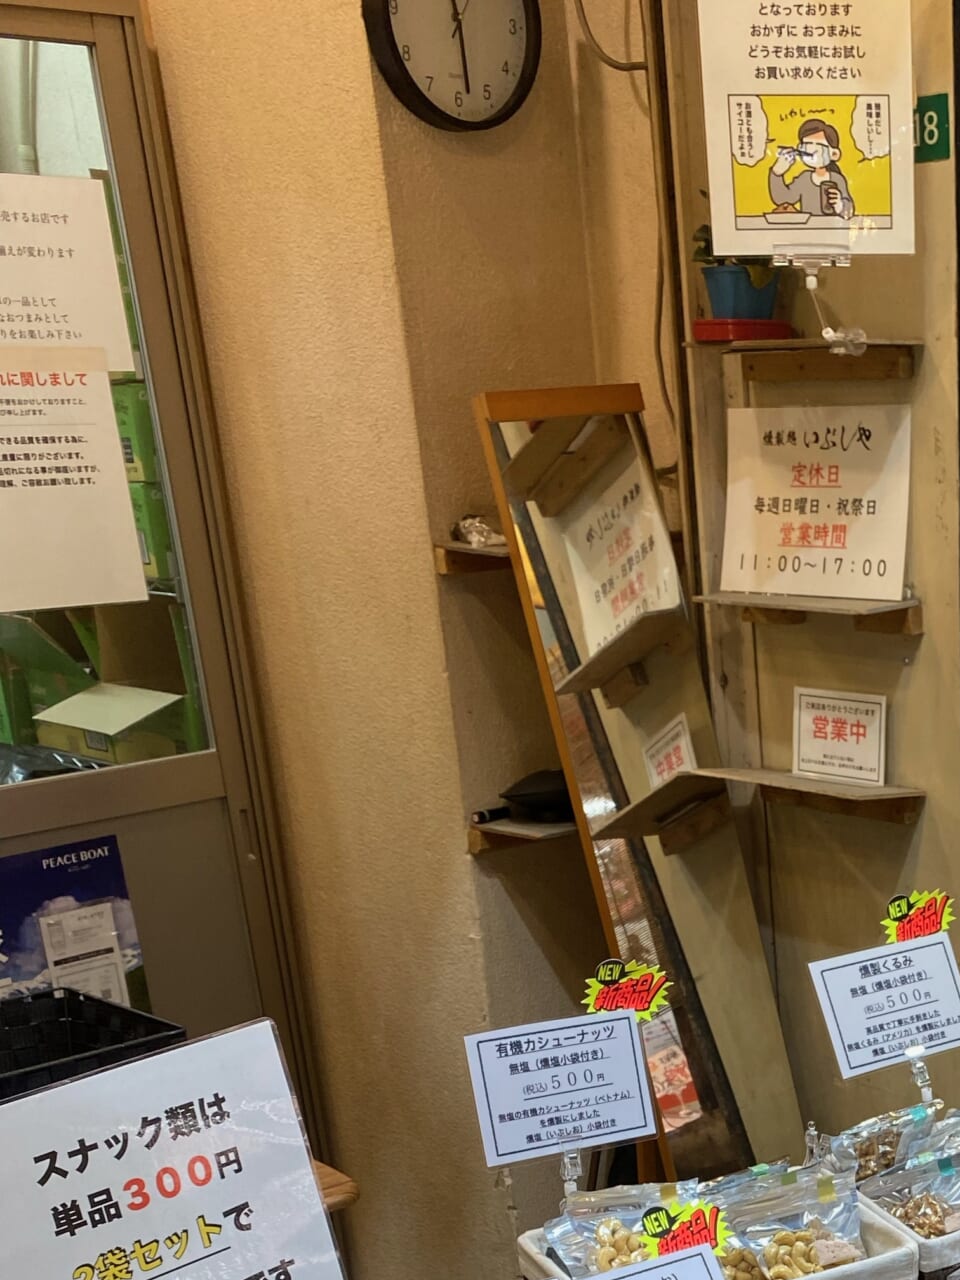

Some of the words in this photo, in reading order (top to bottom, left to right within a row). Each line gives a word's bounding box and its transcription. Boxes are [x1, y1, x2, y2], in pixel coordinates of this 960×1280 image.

[758, 1, 853, 17] となっております
[509, 18, 516, 35] 3
[750, 24, 797, 38] おかずに
[803, 24, 862, 38] おつまみに
[402, 45, 410, 61] 8
[748, 44, 866, 59] どうぞお気軽にお試し
[502, 60, 509, 75] 4
[754, 66, 862, 80] お買い求めください
[425, 76, 434, 92] 7
[483, 84, 491, 100] 5
[454, 92, 462, 107] 6
[0, 296, 56, 308] の一品として
[803, 421, 872, 451] いぶしや
[791, 462, 839, 486] 定休日
[754, 497, 877, 516] 毎週日曜日・祝祭日
[780, 522, 847, 547] 営業時間
[813, 715, 867, 745] 営業中
[42, 852, 79, 869] PEACE
[80, 846, 110, 862] BOAT
[889, 897, 909, 919] NEW
[598, 966, 622, 981] NEW
[859, 955, 913, 978] 燻製くるみ
[495, 1025, 614, 1058] 有機カシューナッツ
[33, 1093, 231, 1187] スナック類は
[51, 1146, 243, 1238] 単品300円
[644, 1210, 669, 1235] NEW
